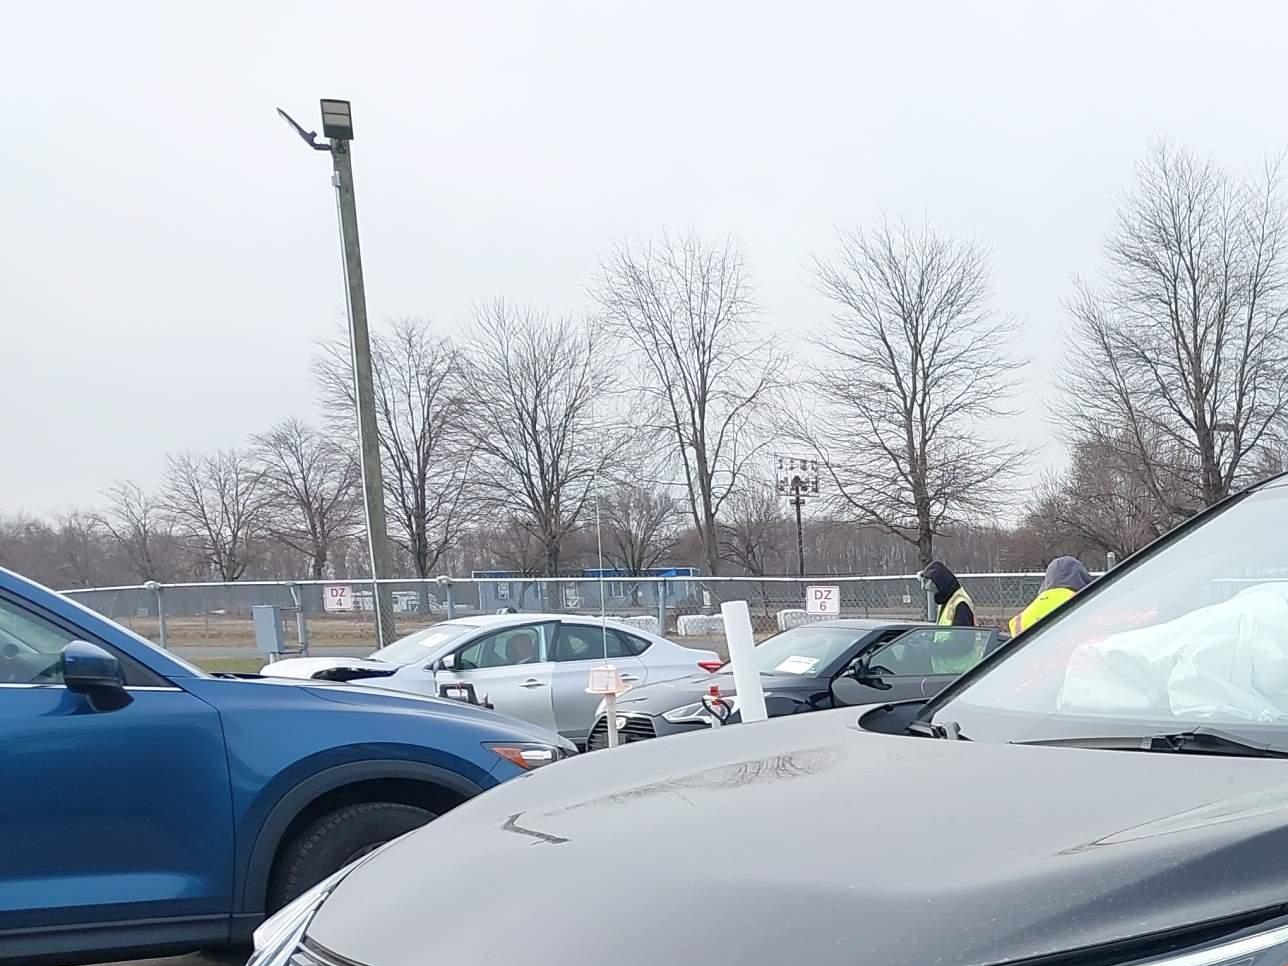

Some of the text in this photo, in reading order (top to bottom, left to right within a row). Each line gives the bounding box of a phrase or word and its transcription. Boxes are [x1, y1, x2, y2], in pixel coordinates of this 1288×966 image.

[330, 587, 346, 598] DZ
[814, 589, 832, 600] DZ
[336, 598, 343, 607] 4
[819, 601, 827, 611] 6
